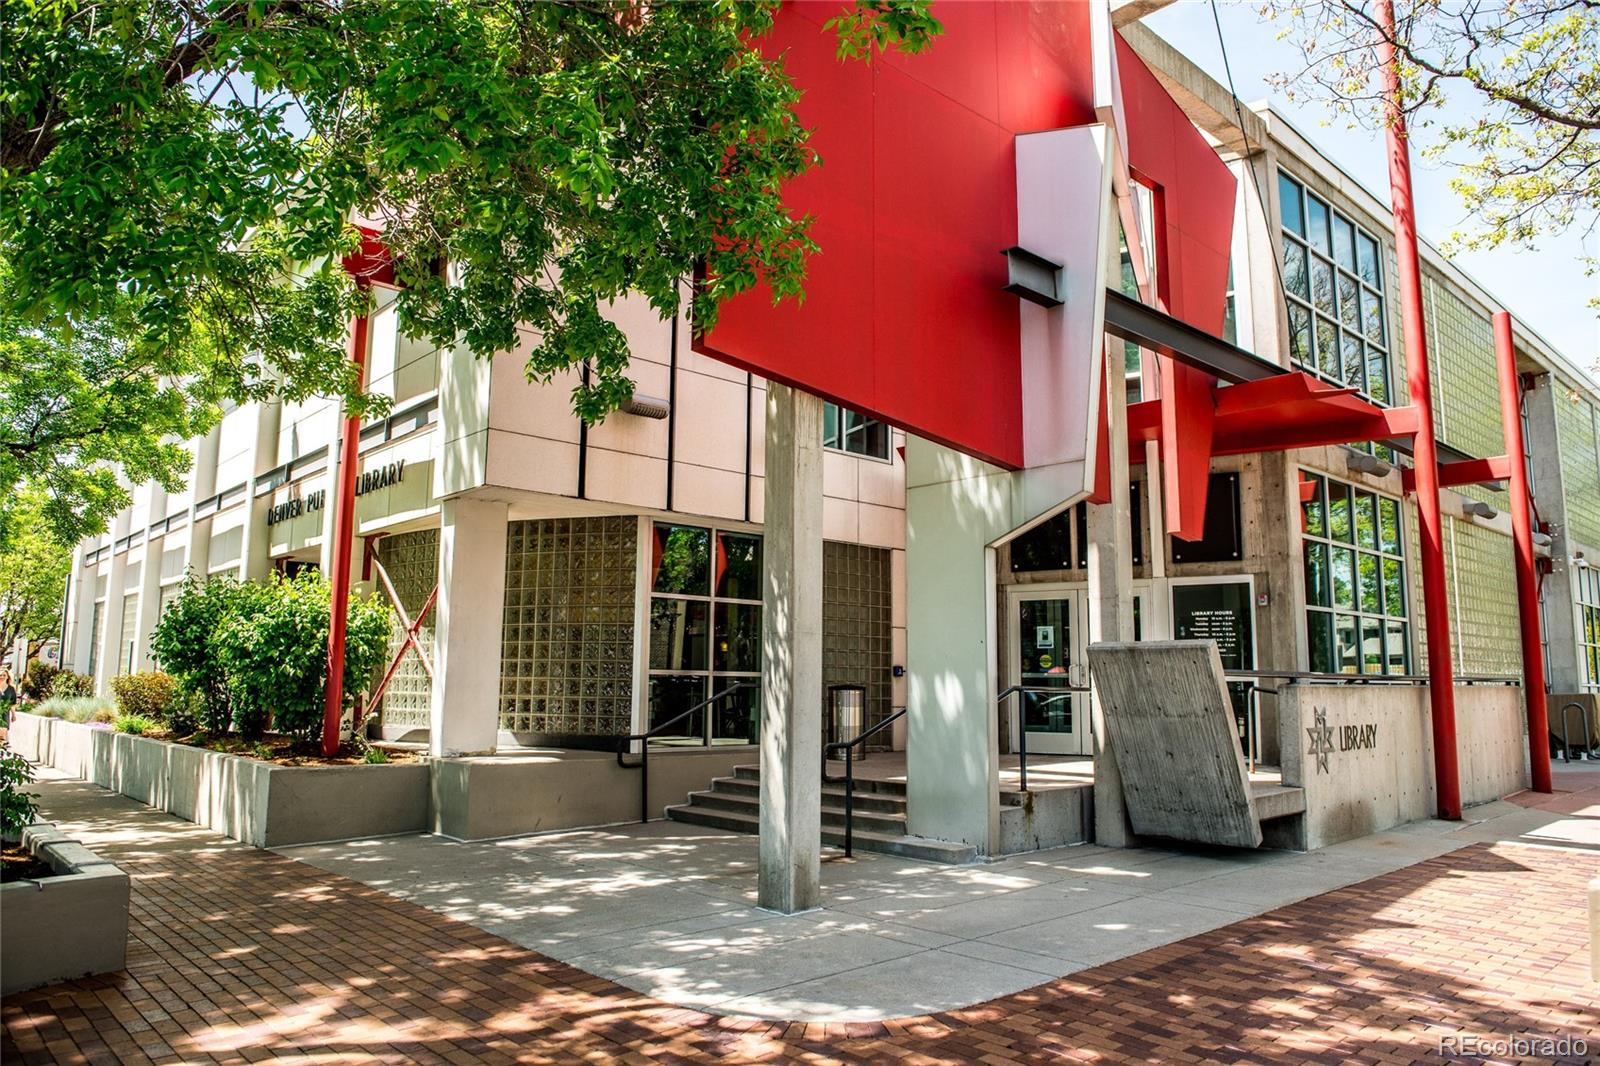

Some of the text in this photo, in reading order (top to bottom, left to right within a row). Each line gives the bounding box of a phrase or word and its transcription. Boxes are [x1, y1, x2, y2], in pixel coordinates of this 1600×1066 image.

[267, 498, 302, 526] DENVER
[355, 458, 405, 497] LIBRARY
[1339, 723, 1377, 752] LIBRARY
